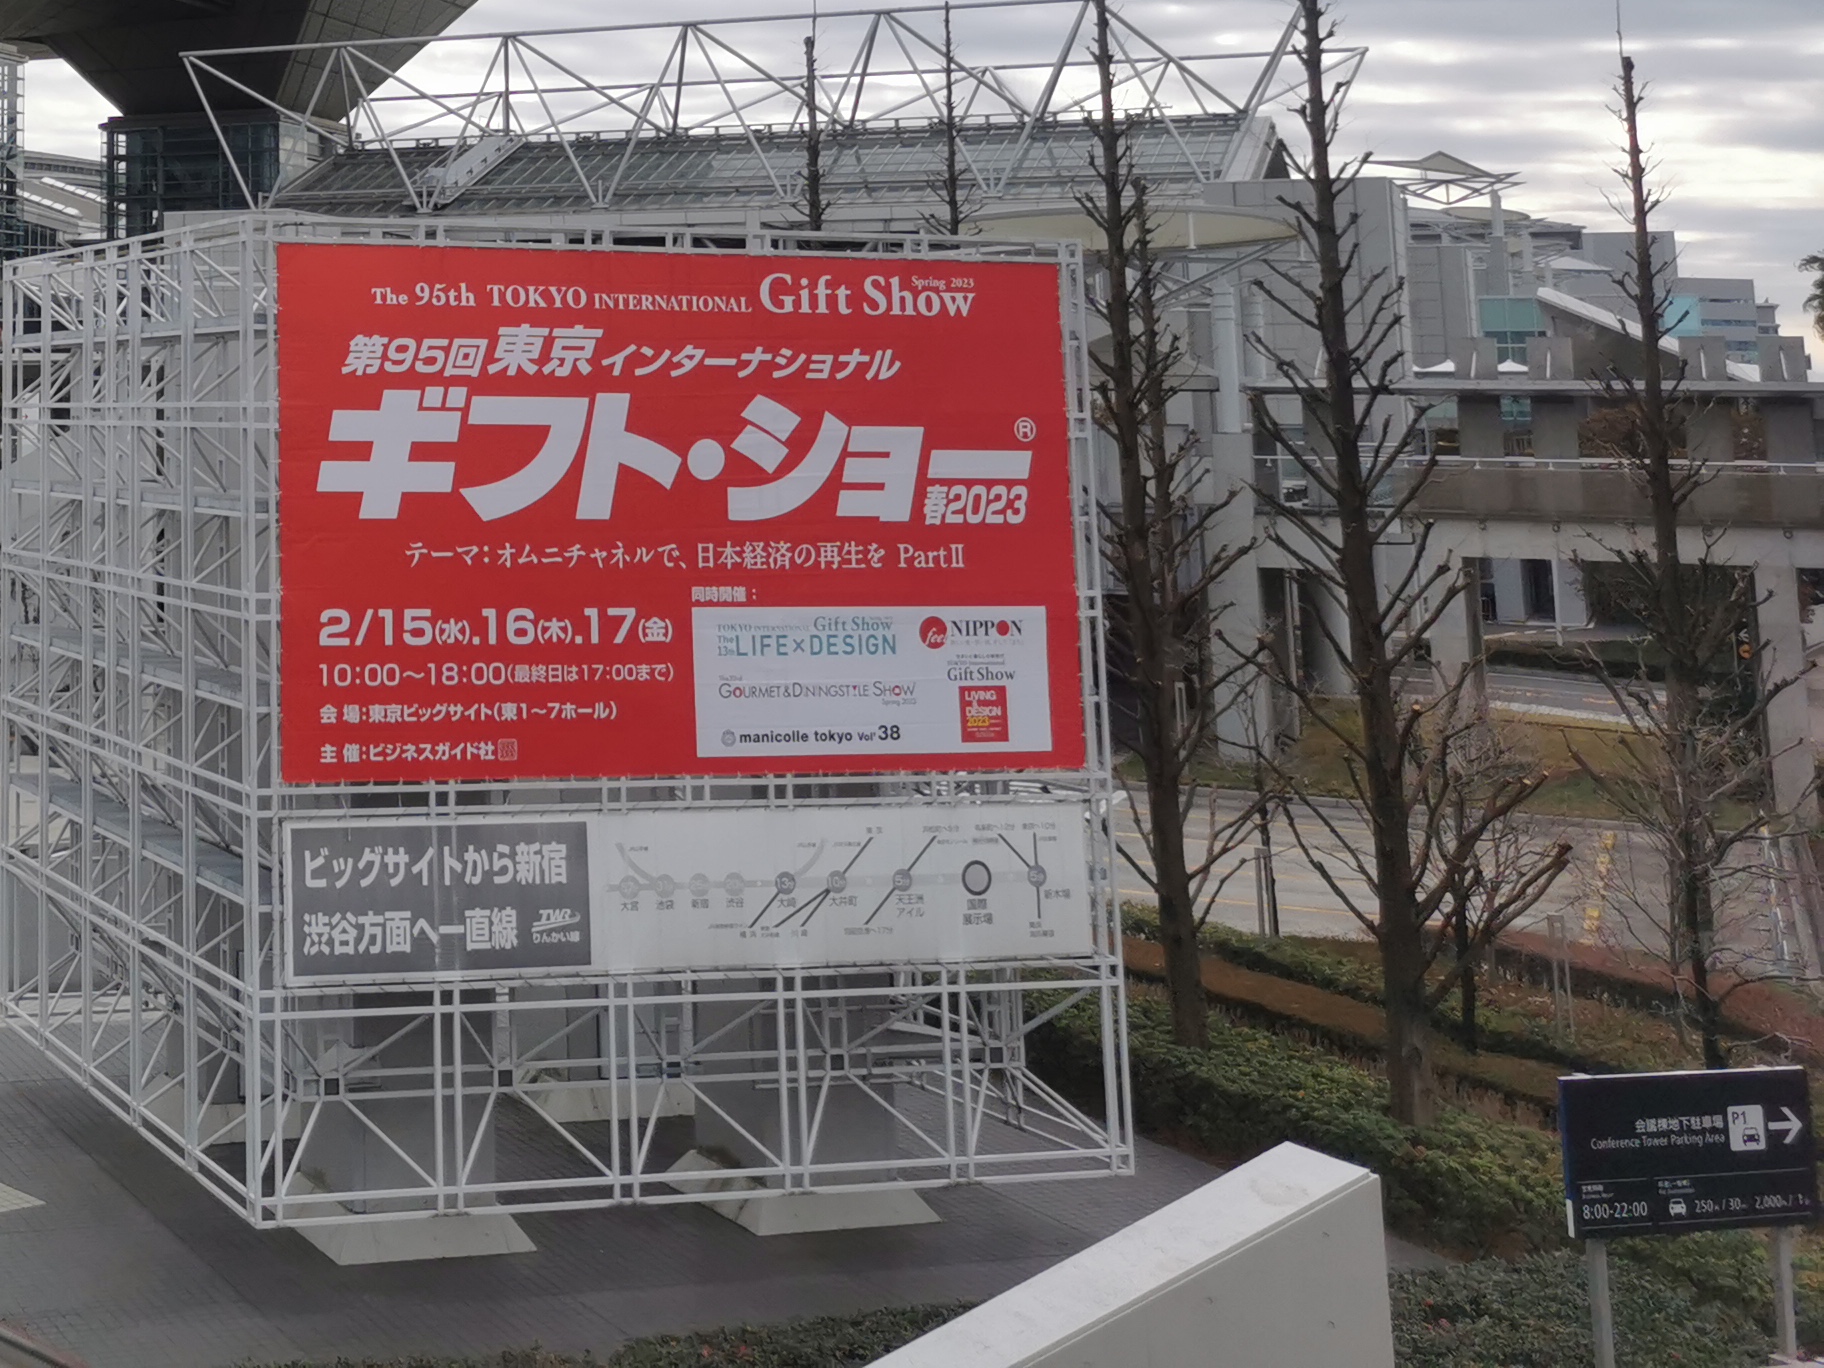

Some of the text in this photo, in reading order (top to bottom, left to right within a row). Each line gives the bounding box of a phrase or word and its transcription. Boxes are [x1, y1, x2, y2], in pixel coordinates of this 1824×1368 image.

[911, 275, 975, 290] Spring 2023
[371, 273, 976, 317] The 95th TOKYO INTERNATIONAL Gift Show
[923, 484, 1028, 525] 春2023
[717, 623, 753, 633] TOKYO
[813, 616, 847, 632] Gift
[851, 616, 893, 632] Show
[717, 635, 734, 644] The
[947, 666, 1016, 682] Gift Show
[739, 730, 809, 744] manicolle
[814, 730, 853, 744] tokyo
[878, 725, 901, 741] 38
[304, 841, 568, 889] ビッグサイトから新宿
[829, 895, 858, 907] 大井町
[303, 906, 518, 956] 渋谷方面へ一直線
[1732, 1111, 1746, 1125] P1
[1590, 1132, 1725, 1150] Conference Tower Parking Area
[1582, 1201, 1648, 1220] 8:00-22:00
